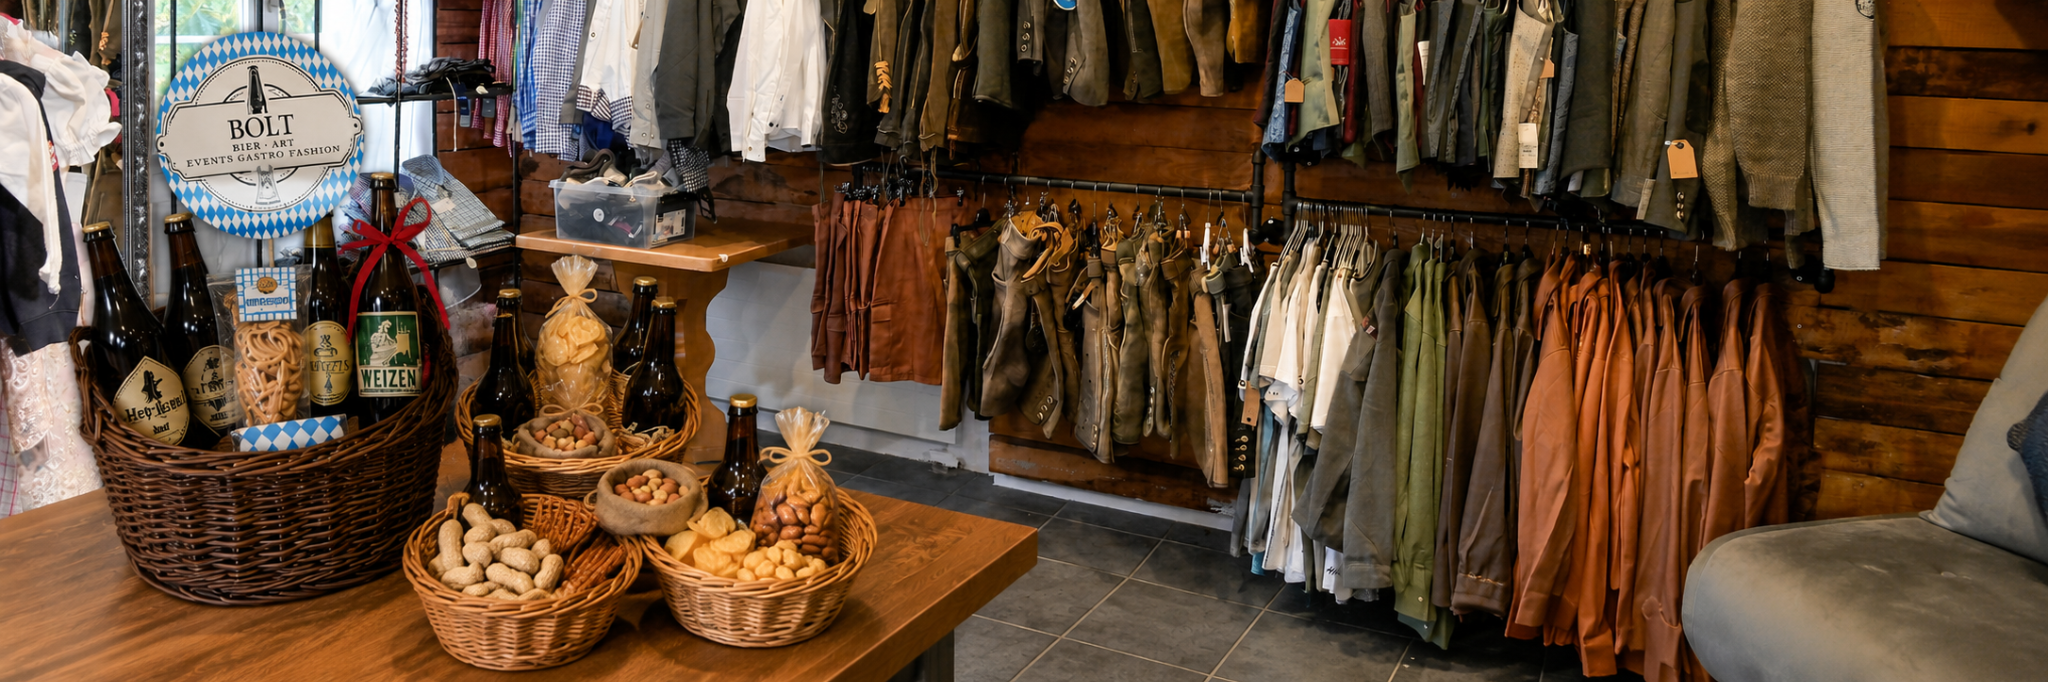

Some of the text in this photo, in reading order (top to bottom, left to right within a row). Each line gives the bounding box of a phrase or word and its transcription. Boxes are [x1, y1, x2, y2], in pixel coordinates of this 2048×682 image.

[227, 114, 294, 140] BOLT
[232, 139, 294, 152] BIER ART
[186, 145, 341, 168] EVENTS GASTRO FASHION
[361, 369, 416, 388] WEIZEN
